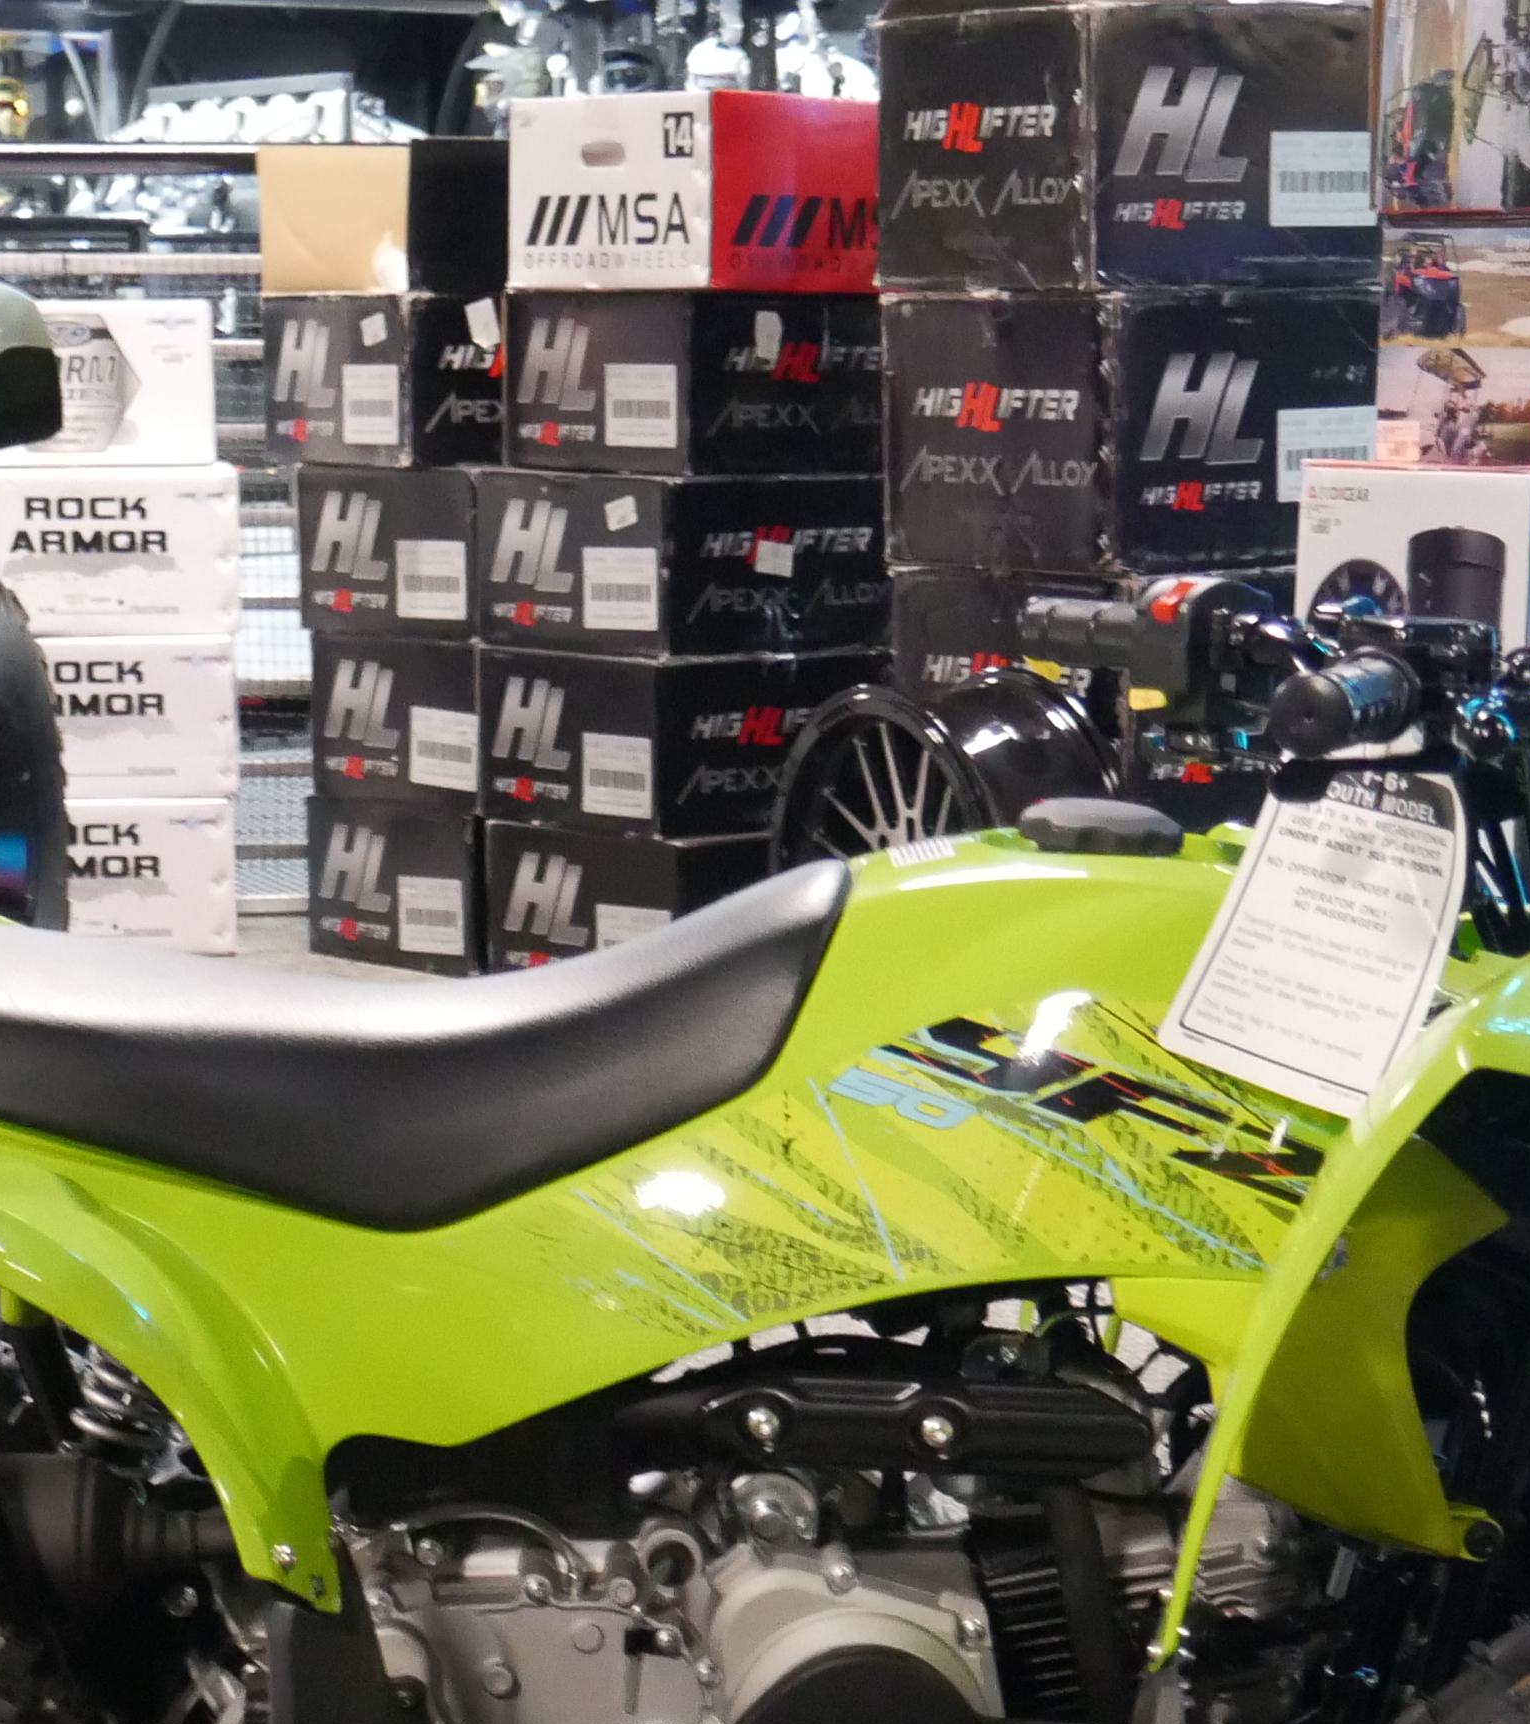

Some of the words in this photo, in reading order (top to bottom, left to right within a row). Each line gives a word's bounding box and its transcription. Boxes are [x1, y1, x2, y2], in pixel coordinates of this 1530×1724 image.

[664, 113, 694, 157] 14
[1114, 66, 1249, 182] HL
[597, 192, 691, 246] MSA
[273, 319, 336, 408] HL
[517, 317, 597, 411] HL
[1140, 352, 1265, 465] HL
[9, 530, 167, 554] ARMOR
[25, 497, 147, 520] ROCK
[311, 490, 389, 581] HL
[490, 498, 574, 593] HL
[54, 661, 144, 683] OCK
[54, 693, 164, 716] MOR
[324, 659, 400, 749] HL
[492, 676, 571, 771] HL
[69, 824, 139, 847] CK
[1326, 780, 1376, 809] OUTH
[1380, 793, 1437, 825] MODEL
[68, 855, 160, 878] MOR
[319, 823, 391, 913] HL
[502, 852, 589, 947] HL
[827, 1065, 977, 1130] 50
